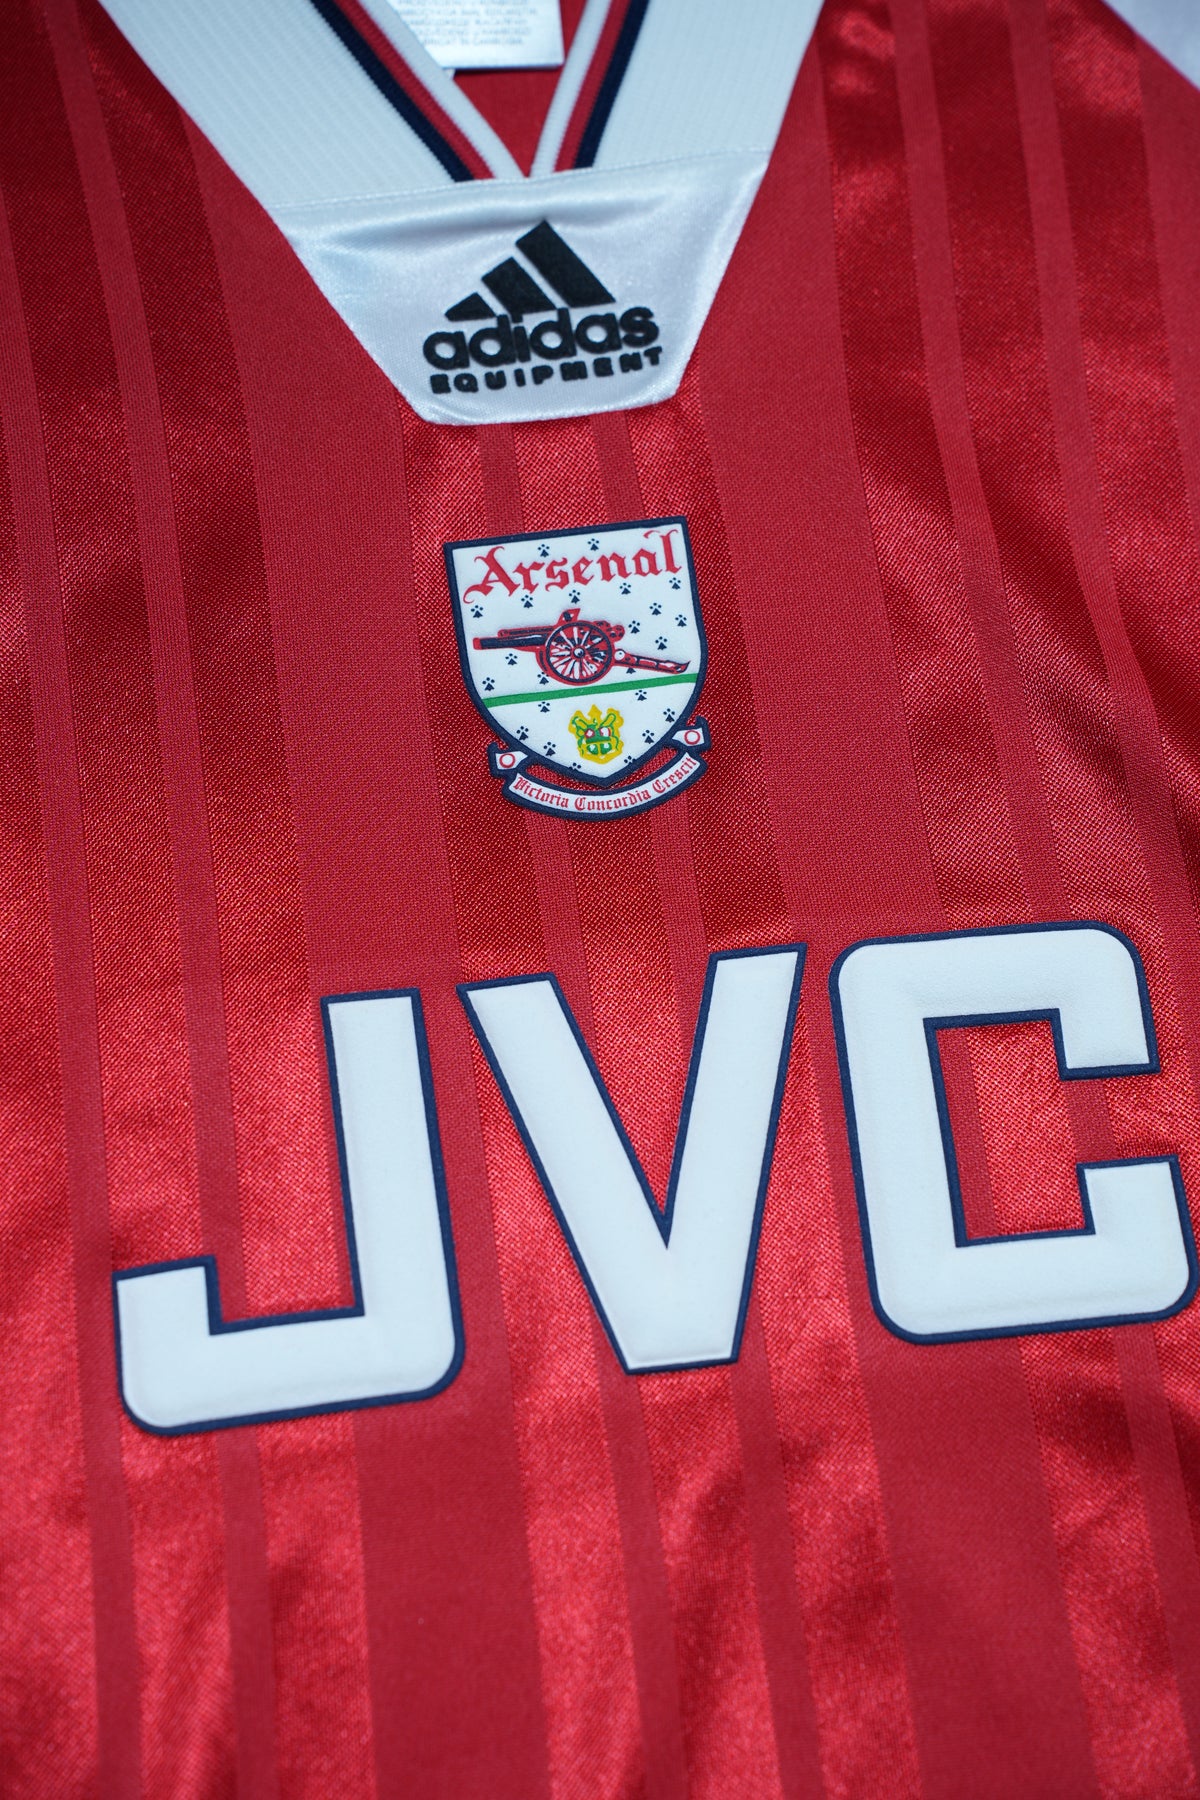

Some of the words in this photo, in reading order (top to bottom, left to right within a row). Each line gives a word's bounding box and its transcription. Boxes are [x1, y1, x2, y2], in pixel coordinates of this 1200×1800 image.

[423, 306, 660, 370] adidas
[430, 346, 663, 394] EQUIPMENT
[463, 528, 682, 604] Arsenal
[514, 776, 569, 809] Victoria
[574, 788, 652, 812] Concordia
[652, 757, 698, 794] Crescit
[114, 920, 1199, 1435] JVC
